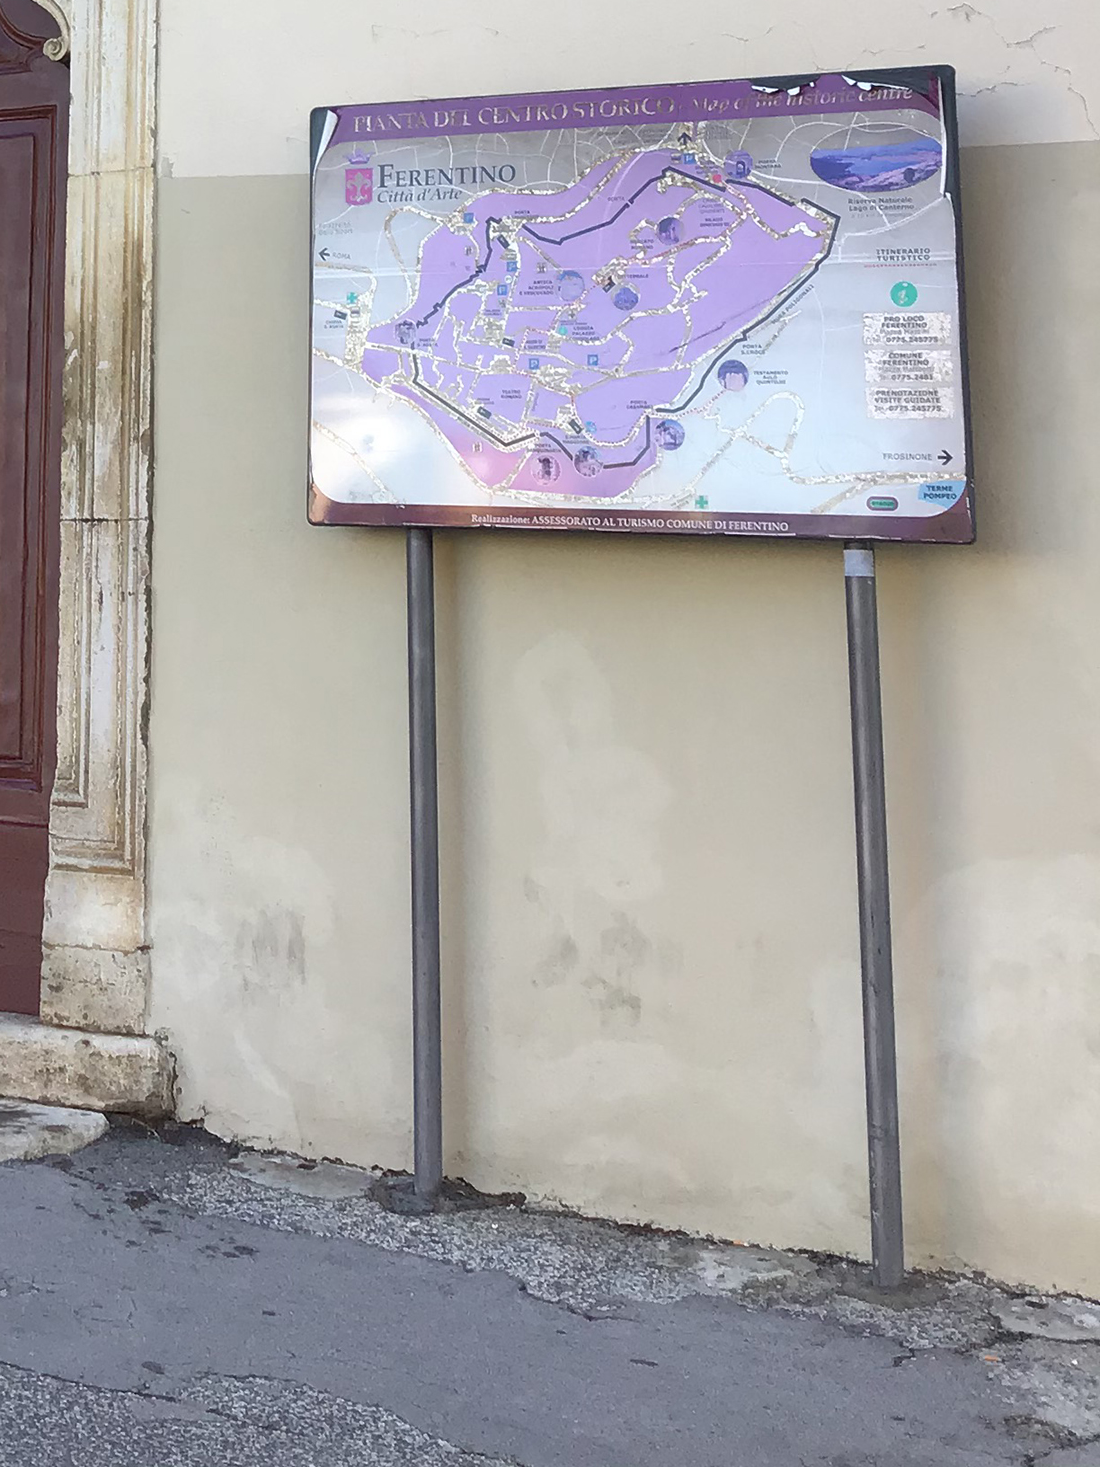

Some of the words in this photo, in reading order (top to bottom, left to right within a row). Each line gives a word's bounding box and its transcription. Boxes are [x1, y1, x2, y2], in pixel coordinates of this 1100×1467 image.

[353, 112, 430, 132] PIANTA
[433, 109, 471, 127] DEL
[478, 103, 569, 125] CENTRO
[573, 96, 675, 119] STORICO
[858, 88, 913, 102] centre
[377, 164, 516, 188] FERENTINO
[377, 189, 413, 203] Città
[417, 188, 463, 203] d'Arte
[876, 247, 931, 255] ITINERARIO
[471, 514, 530, 524] Realizzazione:
[531, 516, 601, 526] ASSESSORATO
[602, 517, 616, 526] AL
[616, 518, 665, 528] TURISMO
[666, 519, 712, 530] COMUNE
[714, 520, 727, 530] DI
[728, 521, 789, 532] FERENTINO
